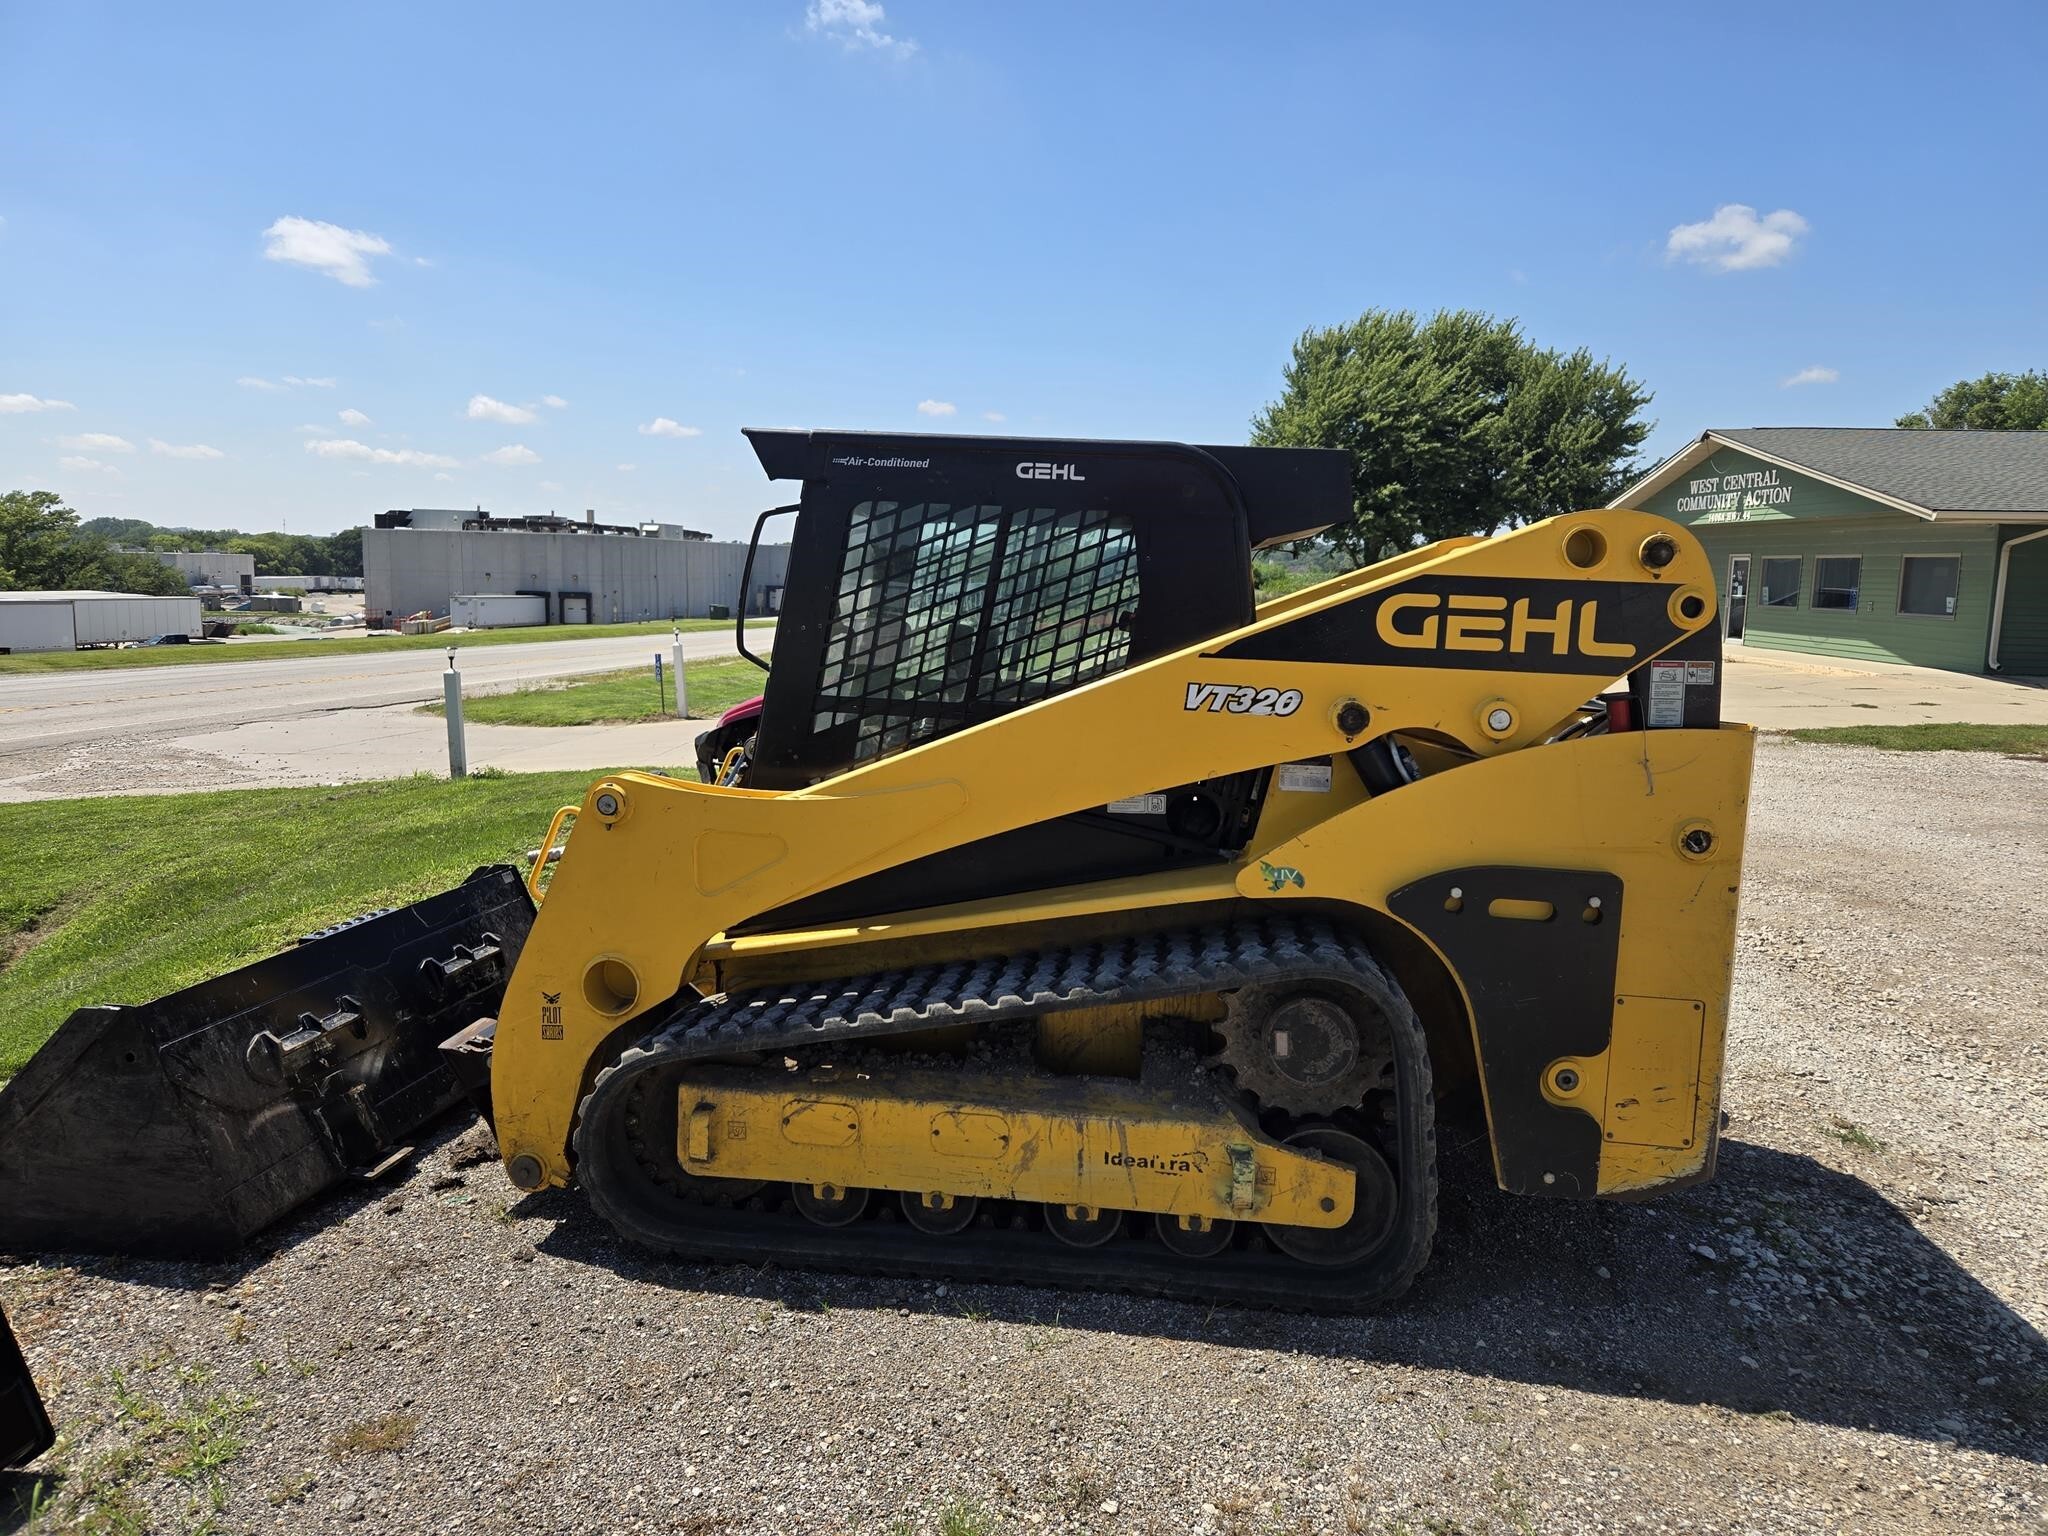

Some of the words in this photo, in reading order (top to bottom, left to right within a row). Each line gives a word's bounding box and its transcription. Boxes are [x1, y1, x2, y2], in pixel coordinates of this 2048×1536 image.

[848, 457, 930, 469] Air-Conditioned
[1015, 462, 1086, 481] GEHL
[1690, 477, 1719, 495] WEST
[1723, 470, 1779, 491] CENTRAL
[1677, 492, 1741, 512] COMMUNITY
[1744, 486, 1793, 507] ACTION
[1375, 593, 1637, 658] GEHL
[1184, 682, 1303, 717] VT320
[542, 1006, 562, 1024] PILOT
